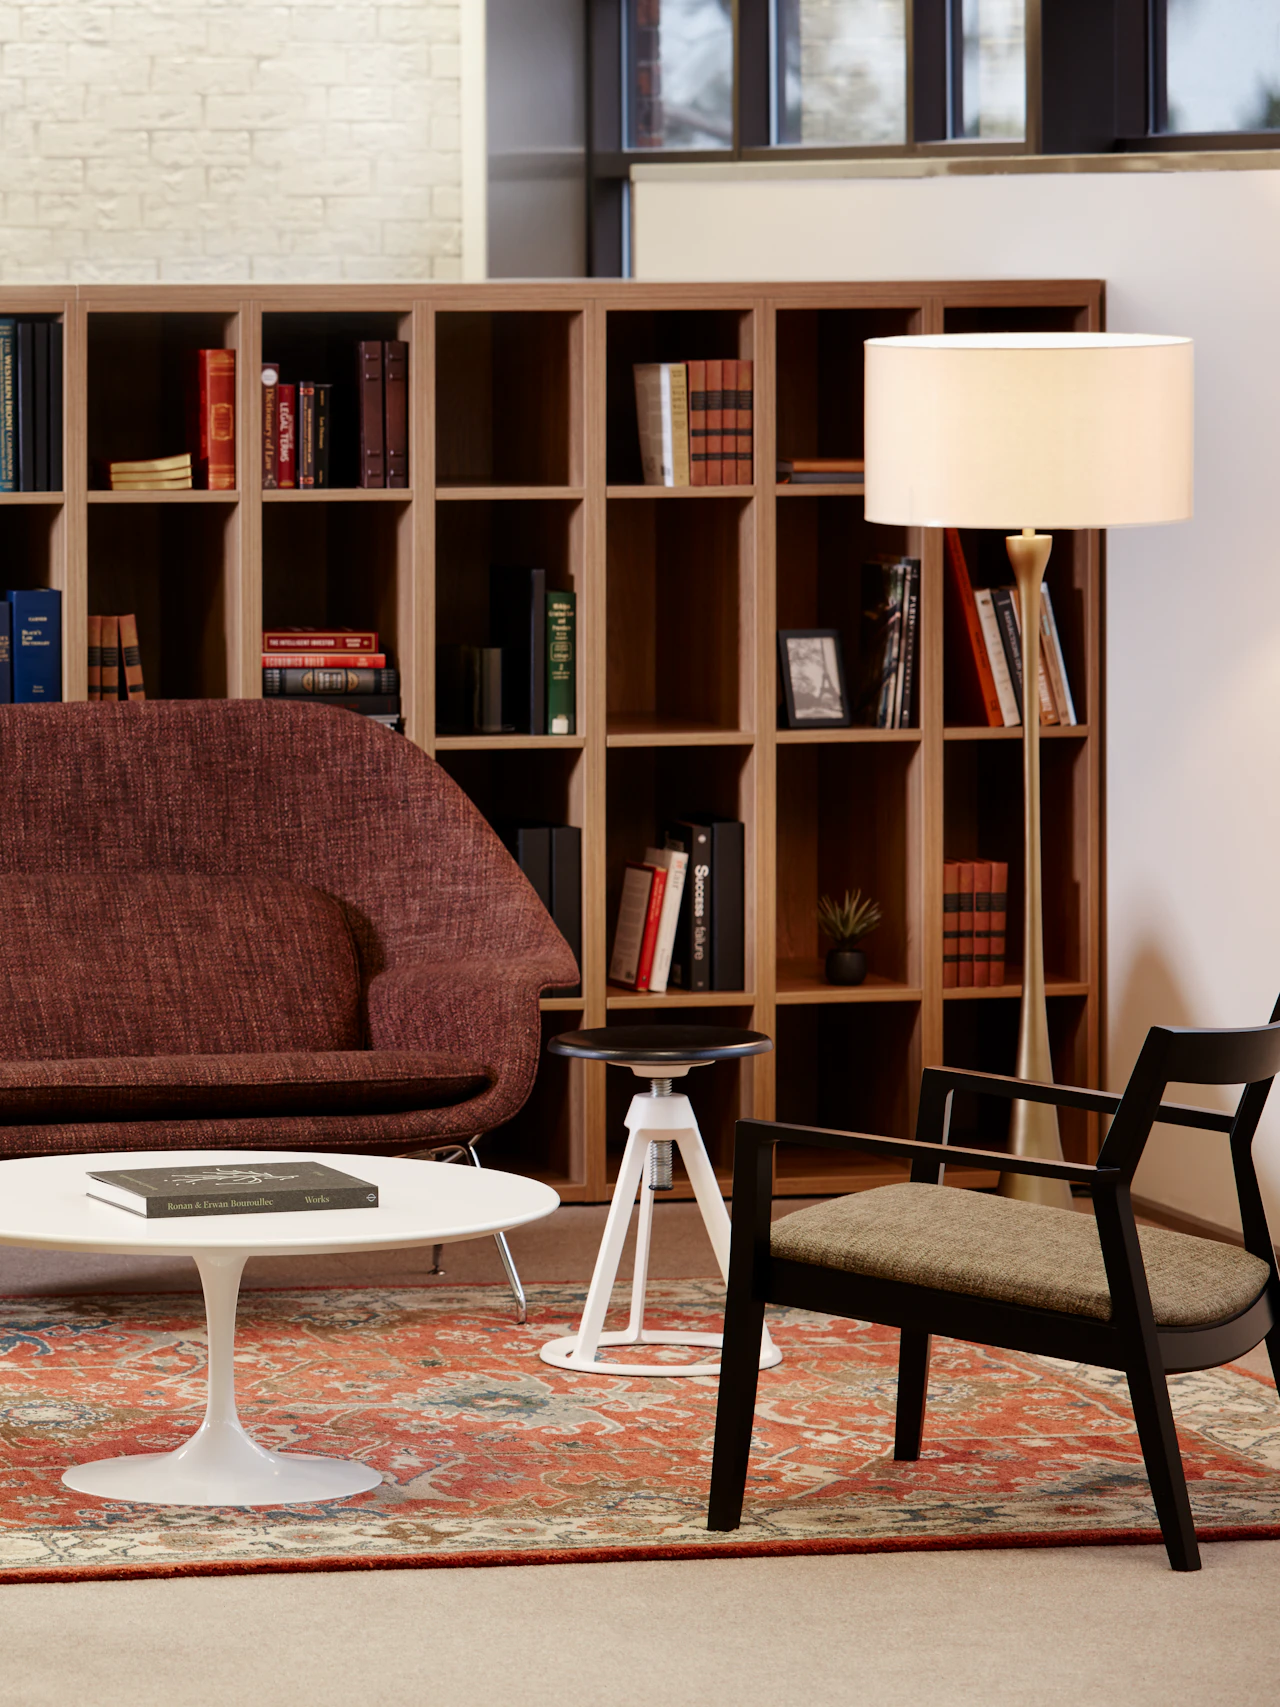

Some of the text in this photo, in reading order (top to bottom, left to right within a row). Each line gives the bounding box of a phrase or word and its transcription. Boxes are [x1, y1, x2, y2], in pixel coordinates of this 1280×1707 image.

[5, 400, 13, 430] FRONT
[263, 388, 275, 470] Dictionary of Law
[280, 402, 289, 462] LEGAL TERMS
[908, 595, 917, 626] PARIS
[265, 657, 303, 667] ECONOMICS
[694, 926, 706, 961] failure
[167, 1197, 274, 1211] Ronan & Erwan Bouroullec
[304, 1195, 330, 1204] Works
